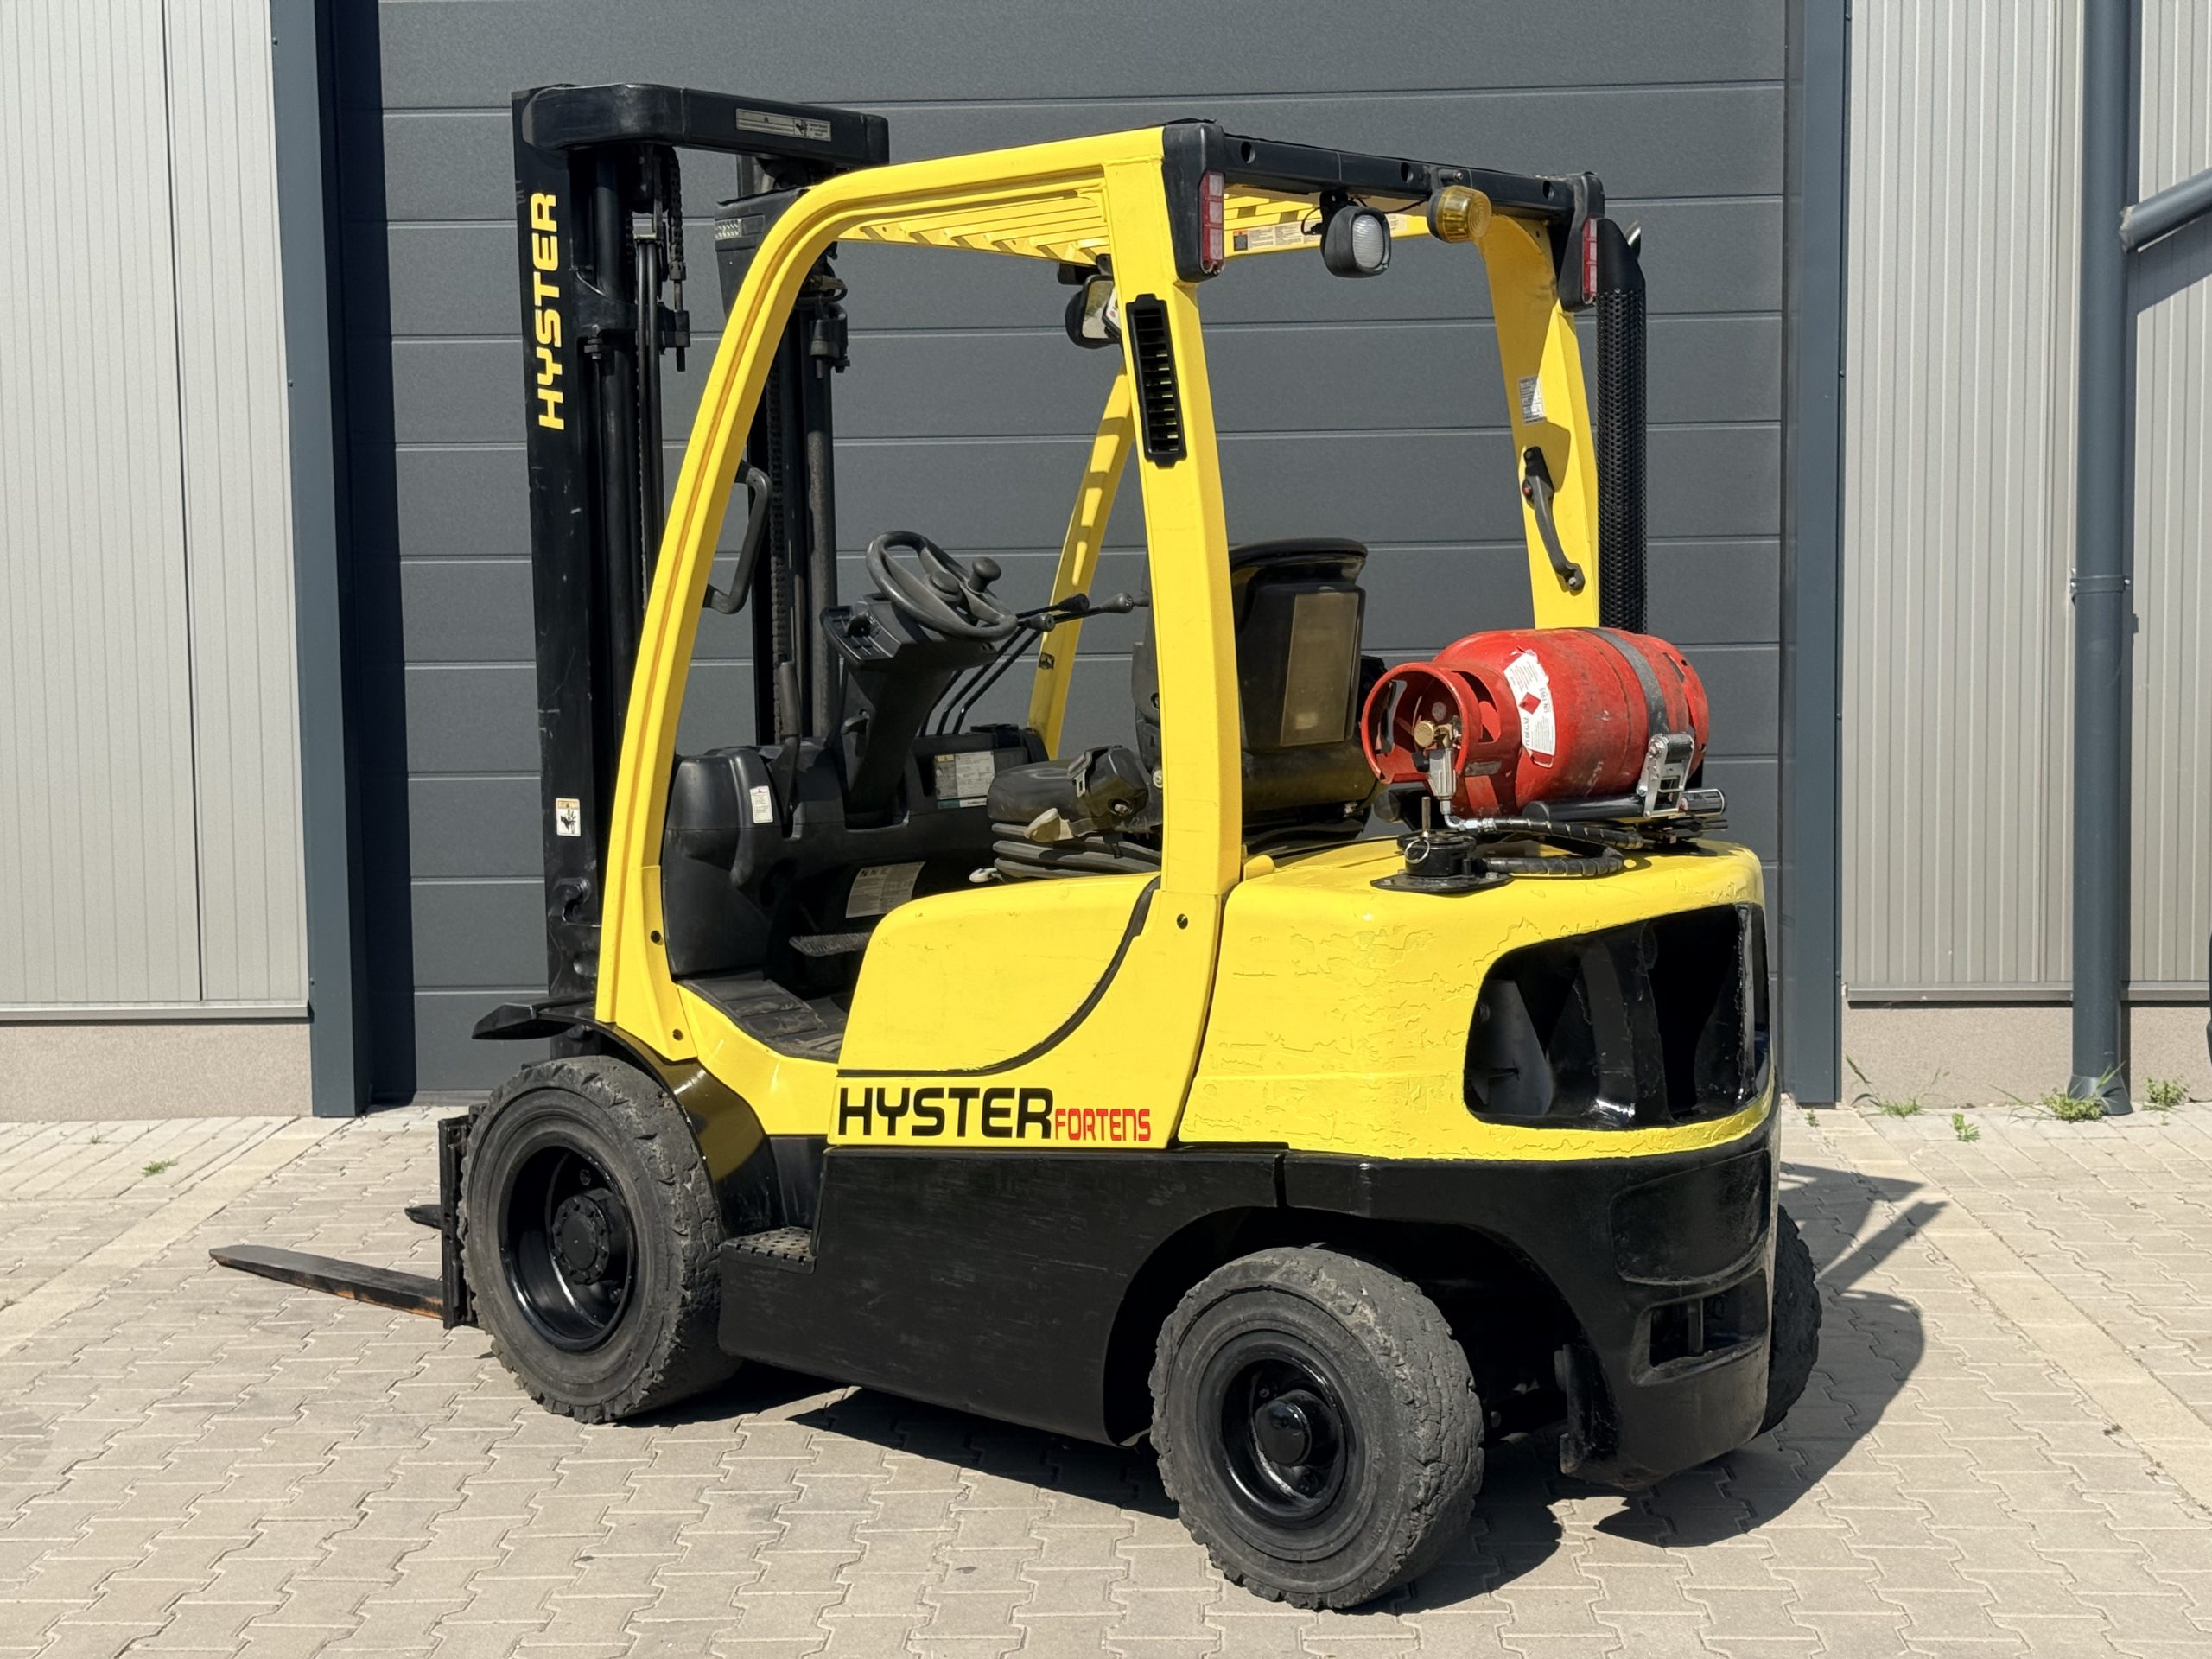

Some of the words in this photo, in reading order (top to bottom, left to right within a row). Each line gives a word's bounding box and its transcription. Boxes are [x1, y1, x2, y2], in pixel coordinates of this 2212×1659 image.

[531, 193, 564, 430] HYSTER
[838, 1087, 1053, 1139] HYSTER
[1054, 1108, 1151, 1141] FORTENS
